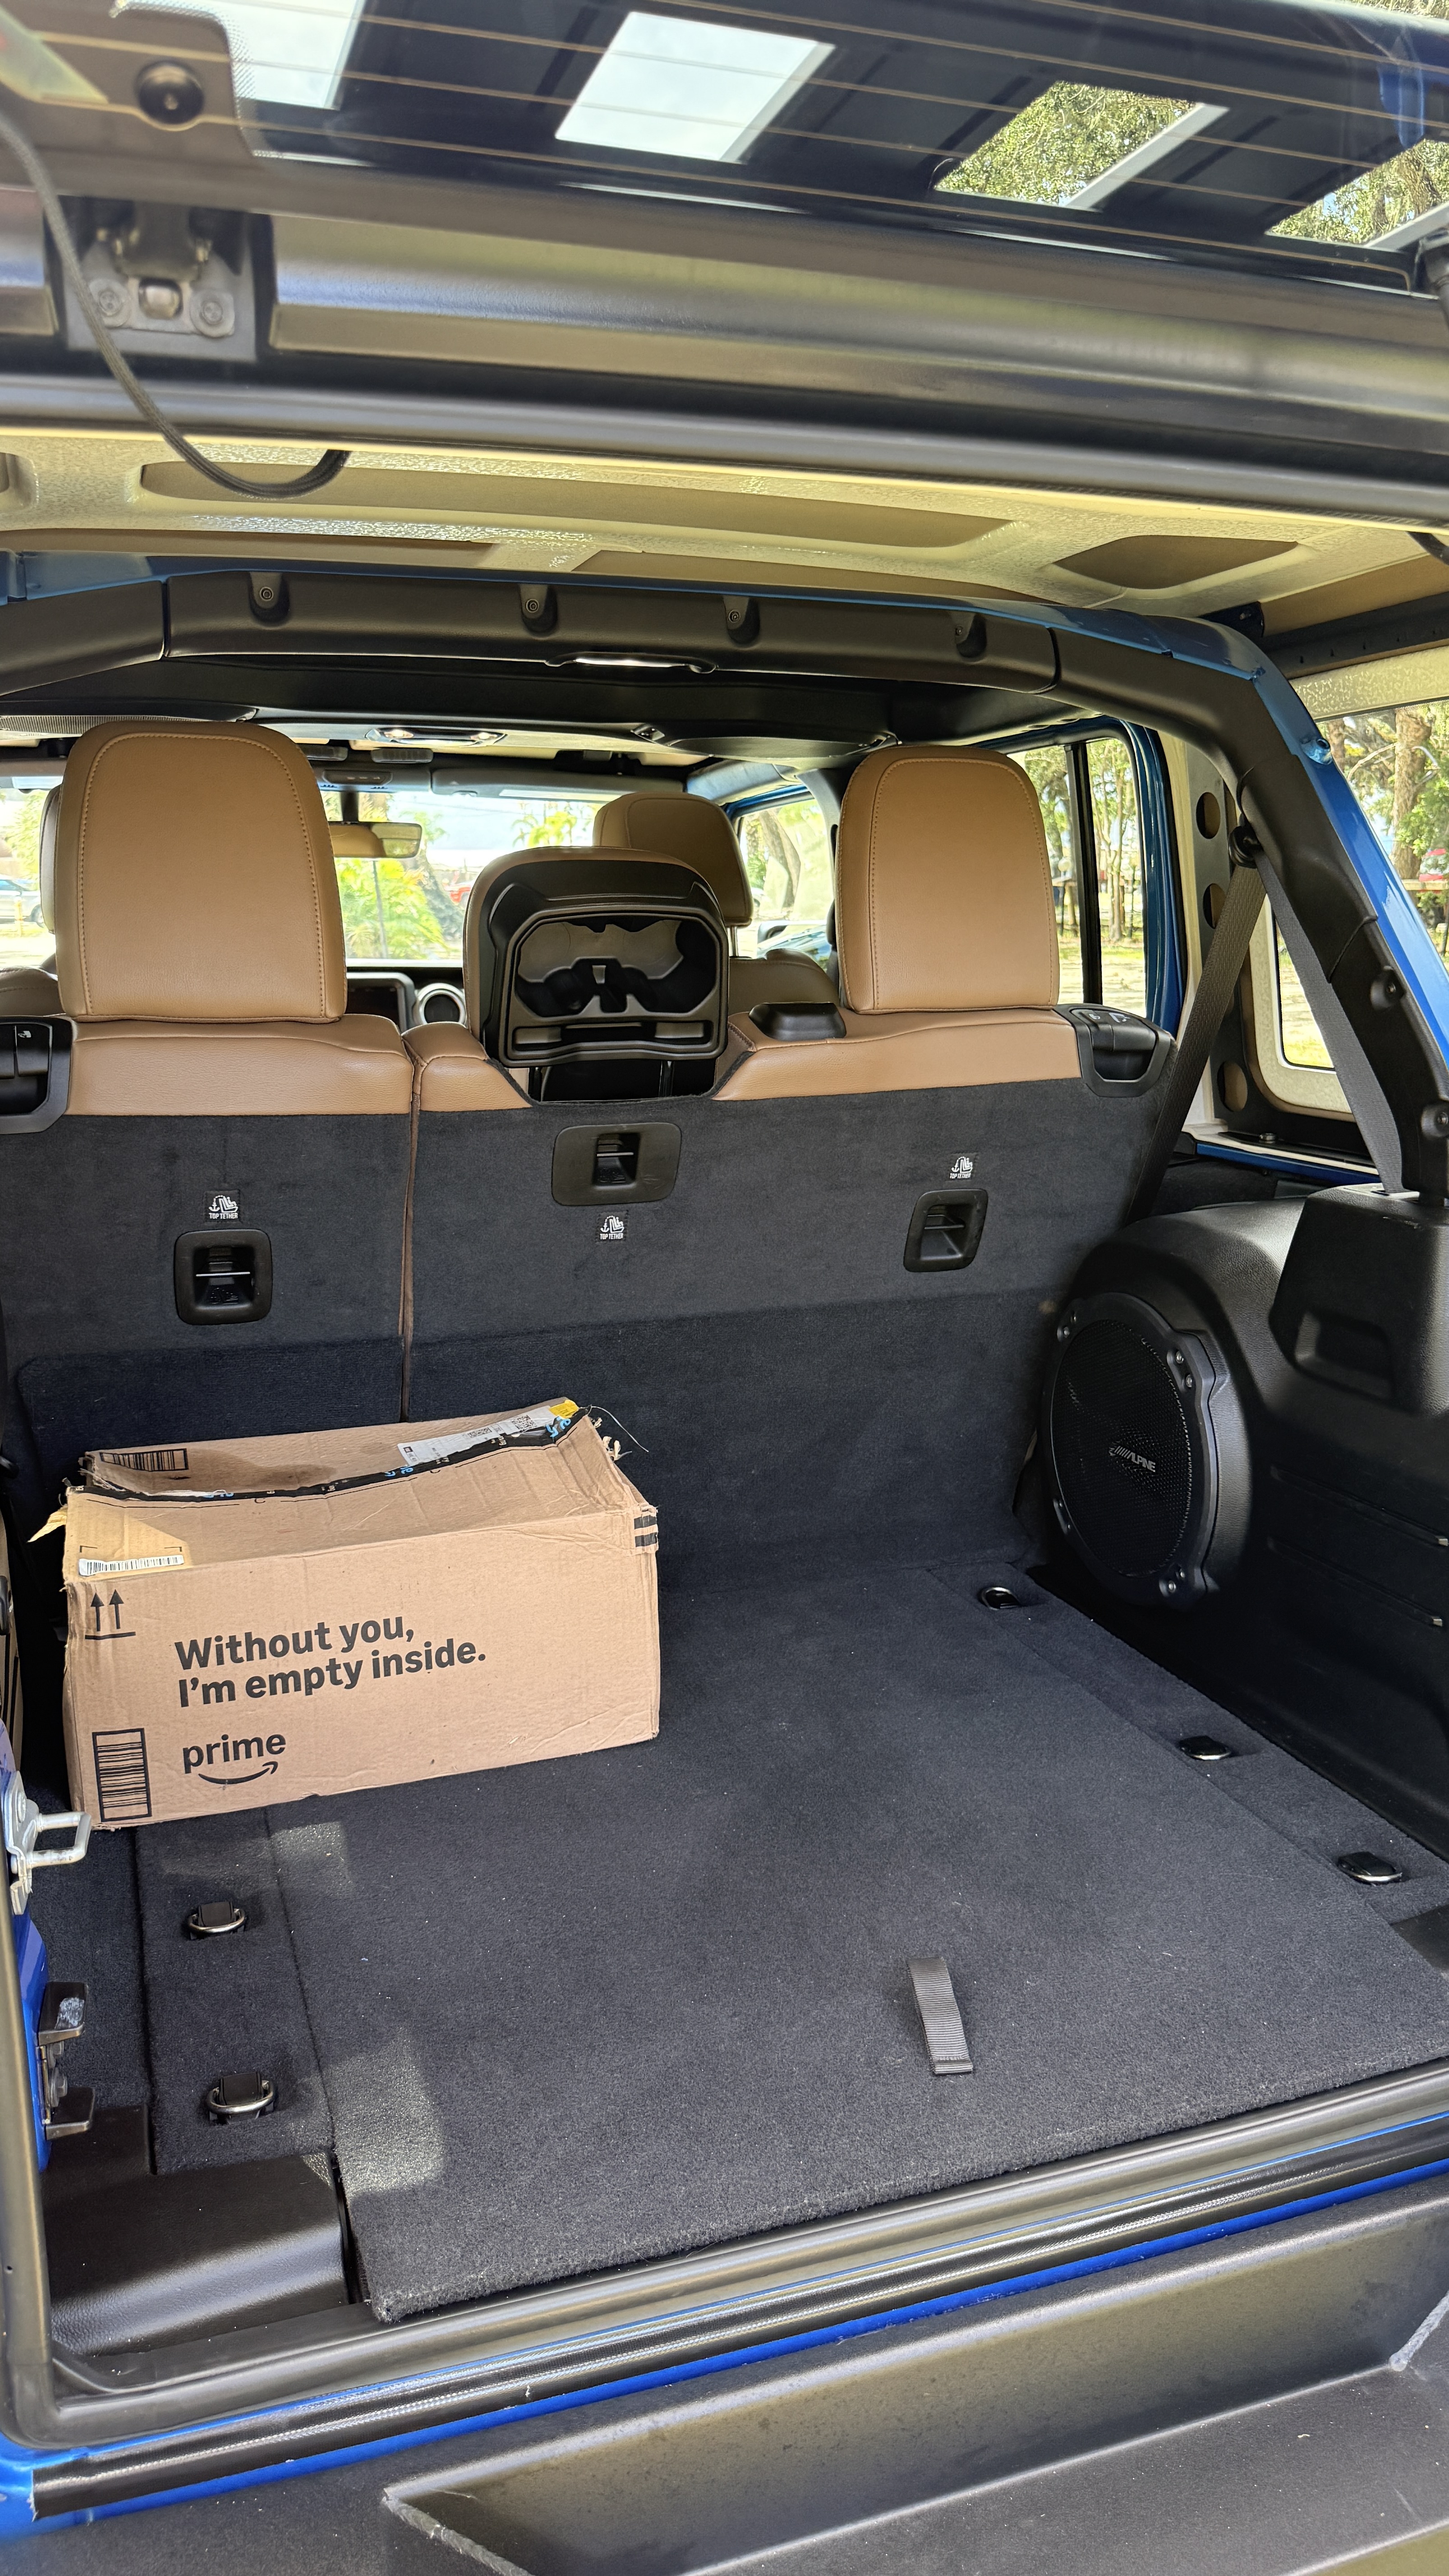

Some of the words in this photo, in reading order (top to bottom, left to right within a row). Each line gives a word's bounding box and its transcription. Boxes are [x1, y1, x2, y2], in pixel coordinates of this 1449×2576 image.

[1126, 1452, 1156, 1472] ALPINE
[175, 1622, 332, 1670] Without
[339, 1616, 414, 1653] you,
[179, 1677, 236, 1708] I’m
[245, 1658, 363, 1698] empty
[372, 1638, 486, 1679] inside.
[183, 1734, 286, 1774] prime
